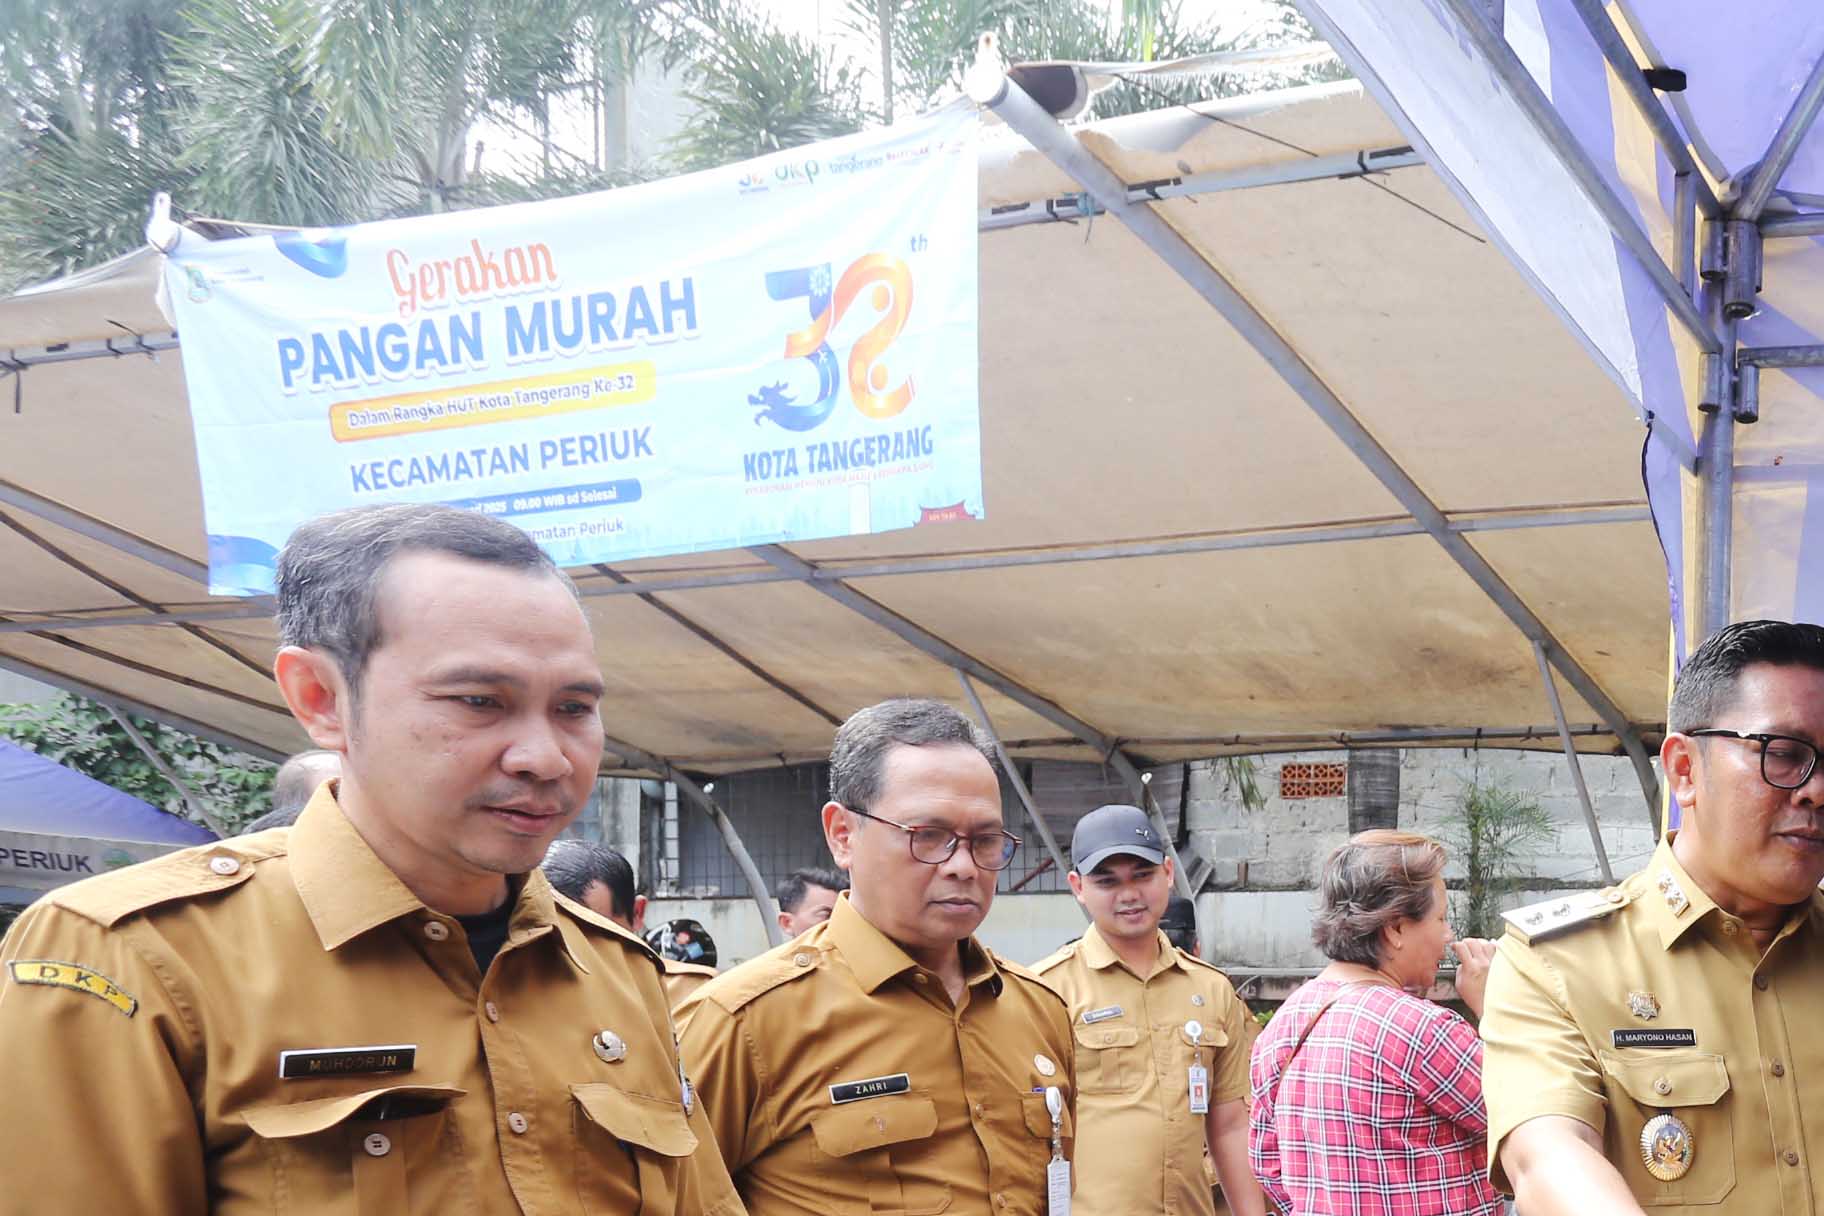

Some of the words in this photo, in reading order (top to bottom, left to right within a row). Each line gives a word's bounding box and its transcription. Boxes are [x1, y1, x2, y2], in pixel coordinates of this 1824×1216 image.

[910, 234, 928, 252] th
[386, 239, 558, 318] Gerakan
[278, 311, 485, 388] PANGAN
[504, 277, 697, 356] MURAH
[349, 410, 391, 426] Dalam
[394, 402, 444, 423] Rangka
[447, 397, 475, 414] HUT
[479, 394, 511, 411] Kota
[514, 381, 591, 405] Tangerang
[350, 443, 530, 493] KECAMATAN
[540, 426, 655, 470] PERIUK
[743, 448, 799, 482] KOTA
[805, 424, 934, 474] TANGERANG
[544, 494, 566, 507] WIB
[581, 487, 617, 503] Selesai
[579, 518, 624, 537] Periuk
[1626, 1033, 1664, 1042] MARYONO
[1666, 1032, 1693, 1042] HASAN
[854, 1081, 888, 1095] ZAHRI
